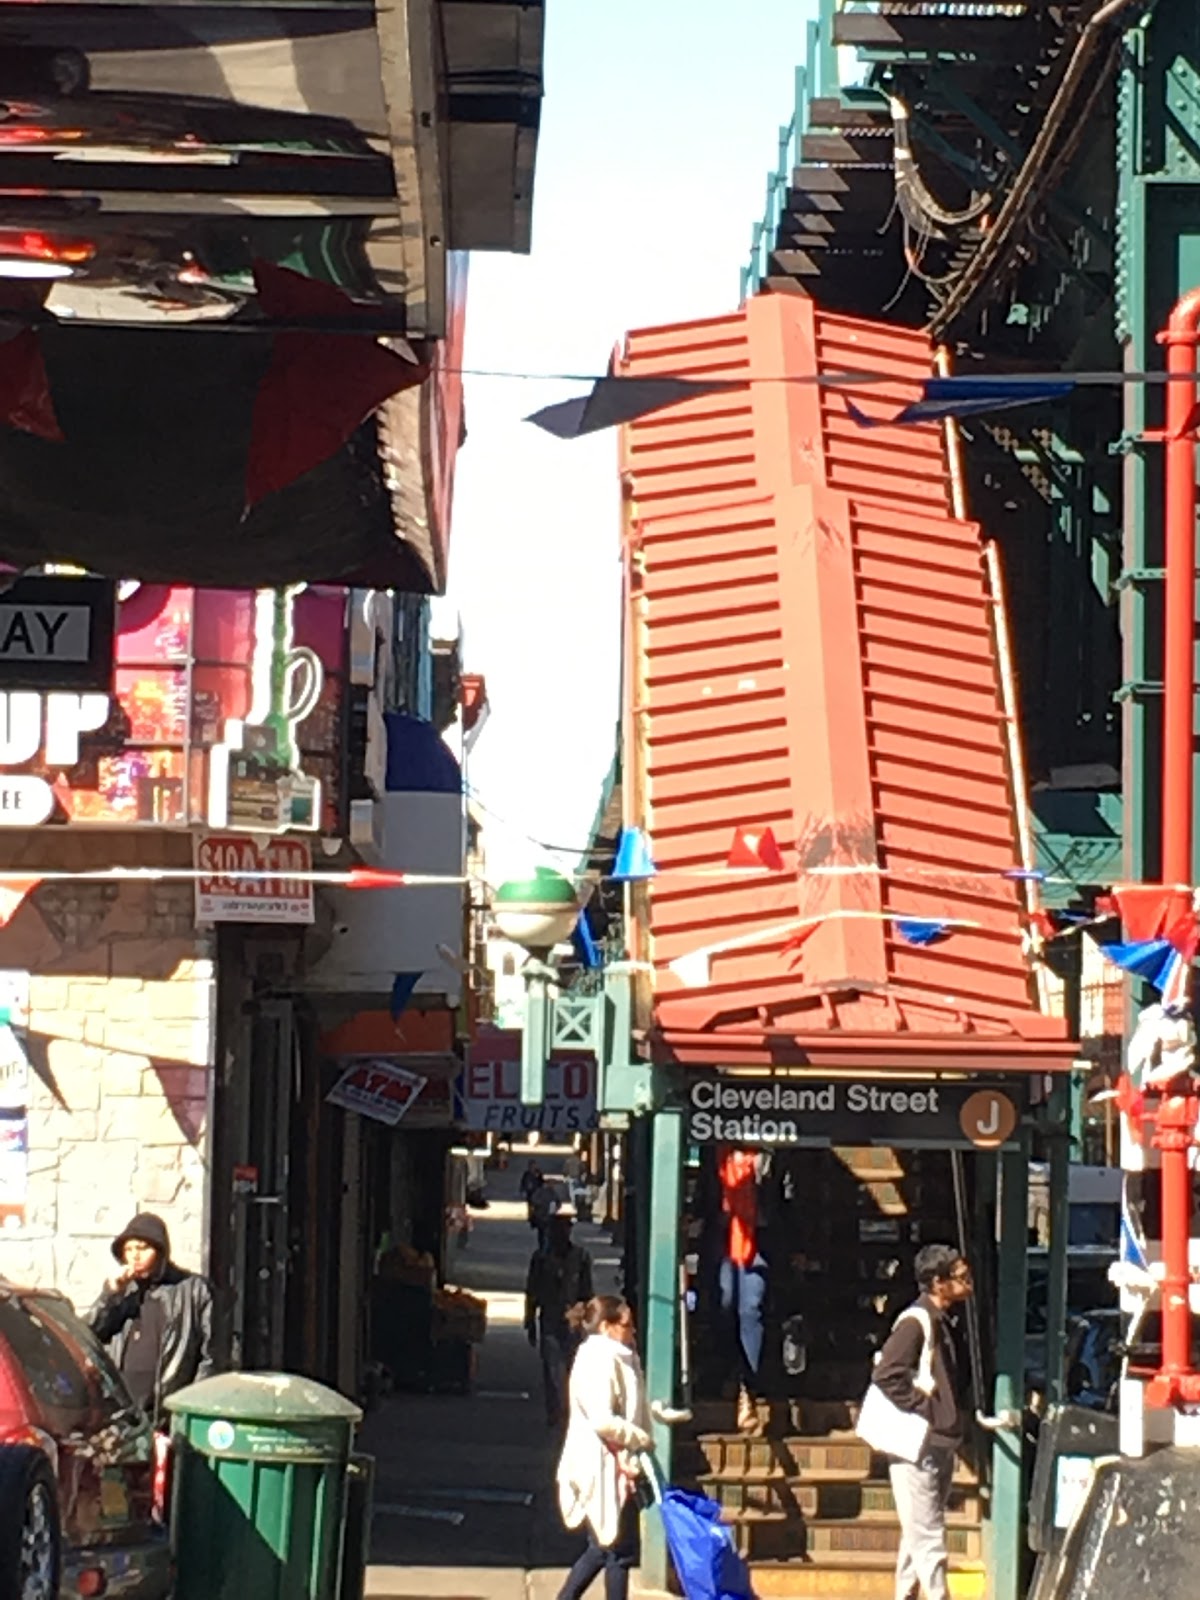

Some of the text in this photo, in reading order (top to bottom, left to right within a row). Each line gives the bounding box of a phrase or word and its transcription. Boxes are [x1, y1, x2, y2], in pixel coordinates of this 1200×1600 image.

[691, 1081, 939, 1113] Cleveland Street
[484, 1104, 580, 1129] FRUITS
[690, 1111, 798, 1143] Station
[976, 1099, 999, 1135] J
